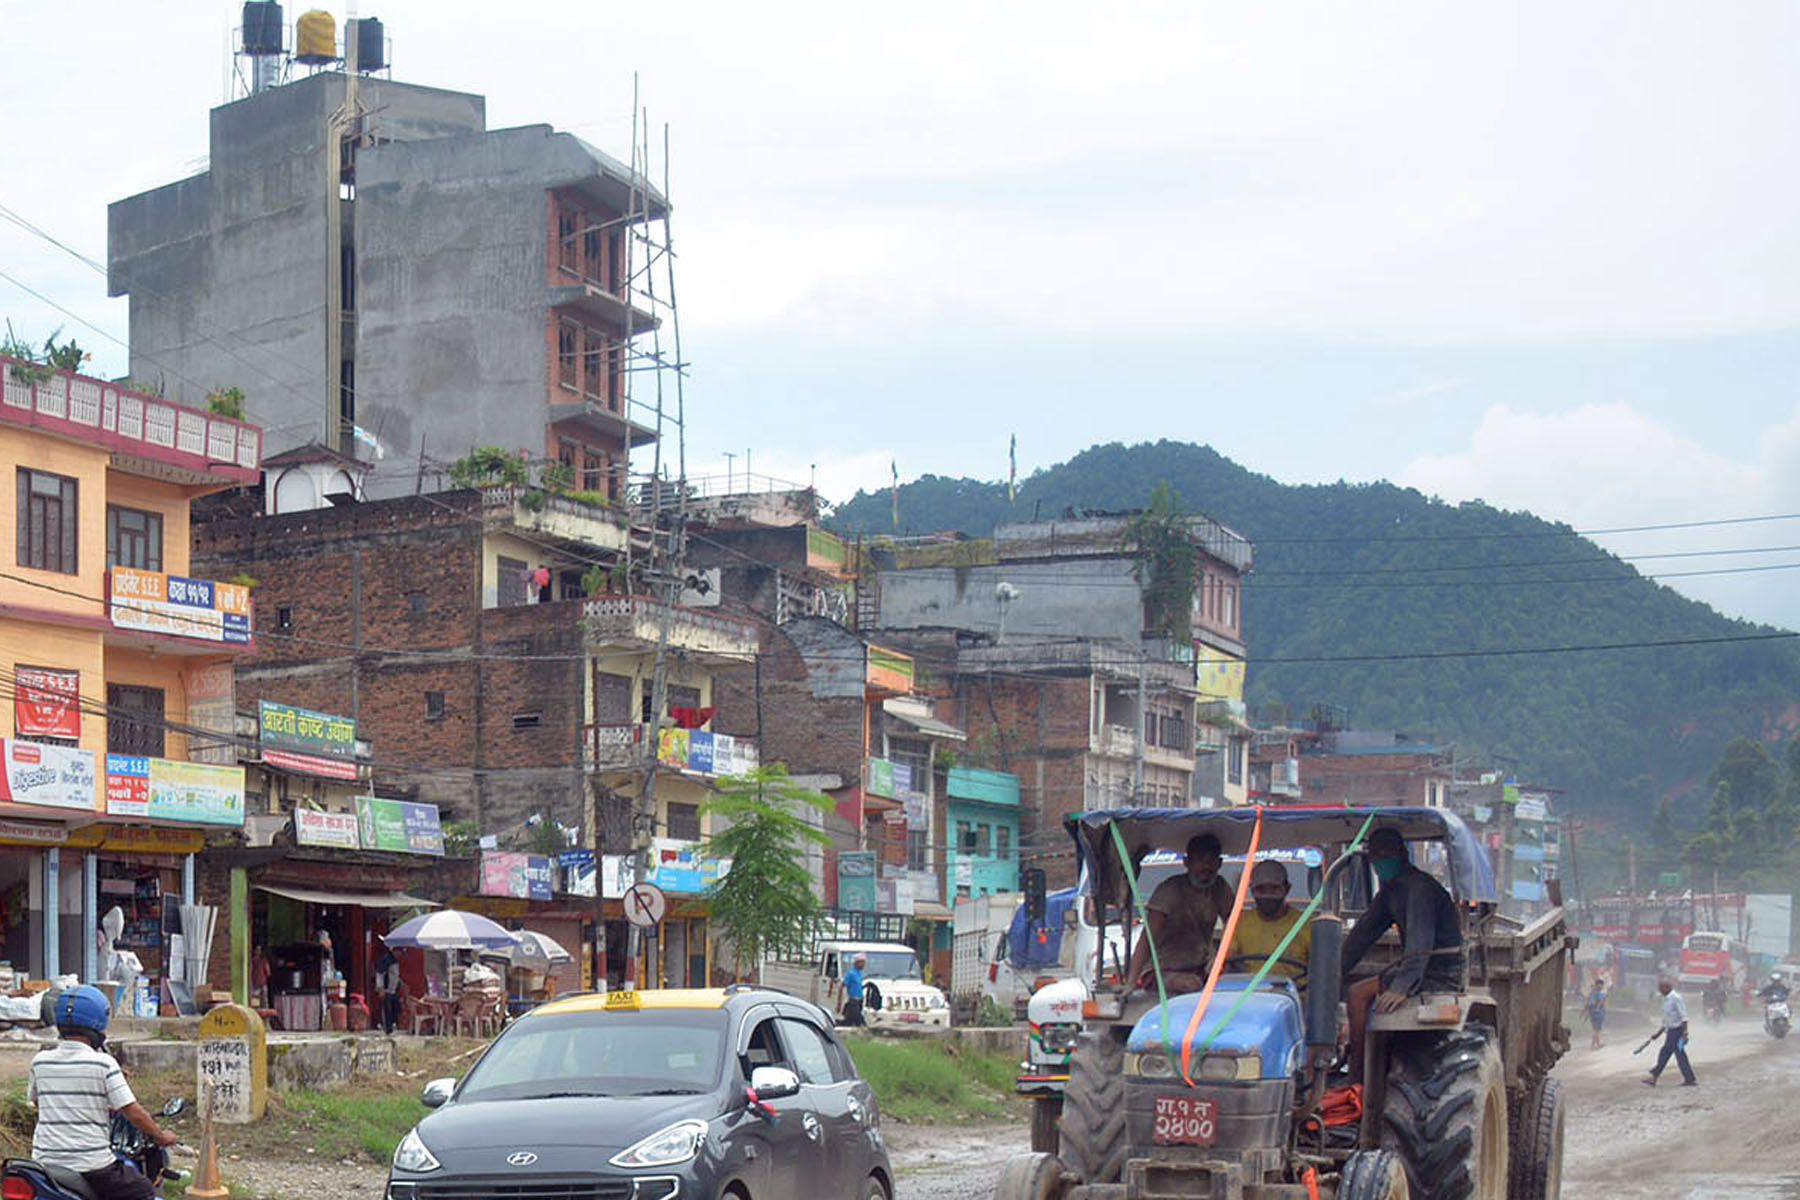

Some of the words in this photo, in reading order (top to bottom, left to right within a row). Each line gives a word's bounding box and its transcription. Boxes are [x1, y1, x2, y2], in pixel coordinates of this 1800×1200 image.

[262, 709, 296, 735] आरती
[607, 990, 633, 1002] TAXI
[1155, 1115, 1214, 1139] २४७०
